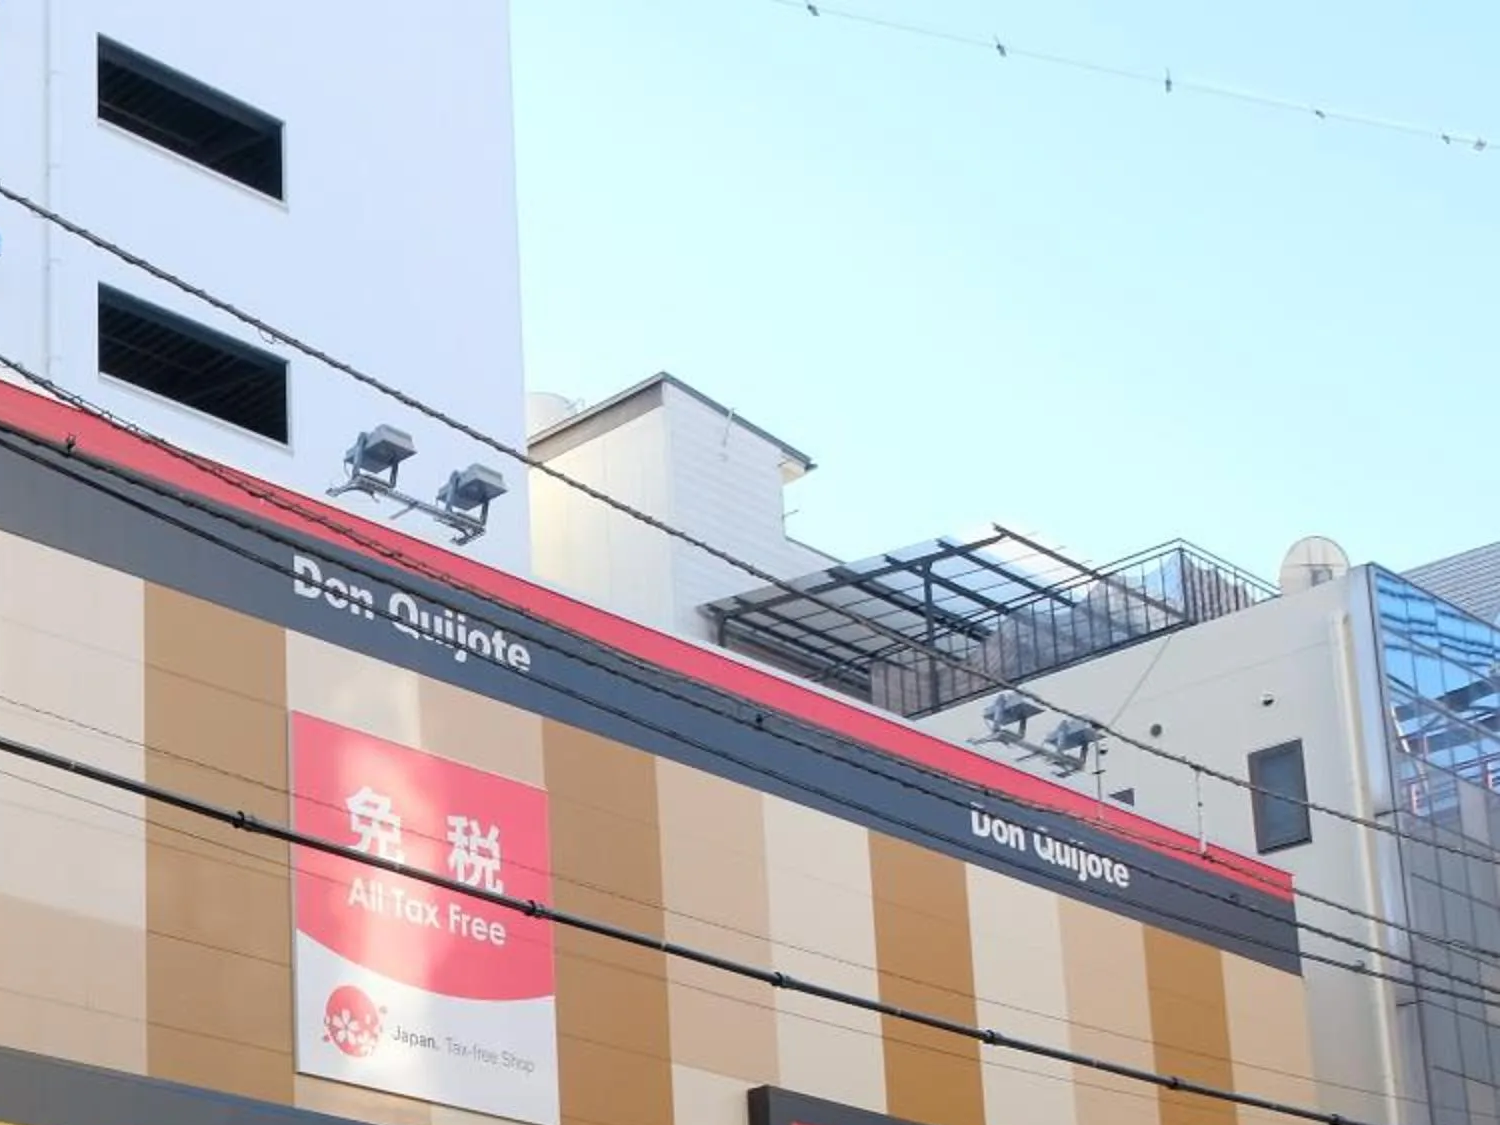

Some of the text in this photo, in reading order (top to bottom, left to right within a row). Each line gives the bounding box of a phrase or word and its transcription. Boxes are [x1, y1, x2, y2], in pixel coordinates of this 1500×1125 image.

[293, 554, 532, 672] Don Quijote
[345, 785, 505, 895] 免税
[969, 802, 1132, 888] Don Quijote
[348, 877, 507, 946] All Tax Free
